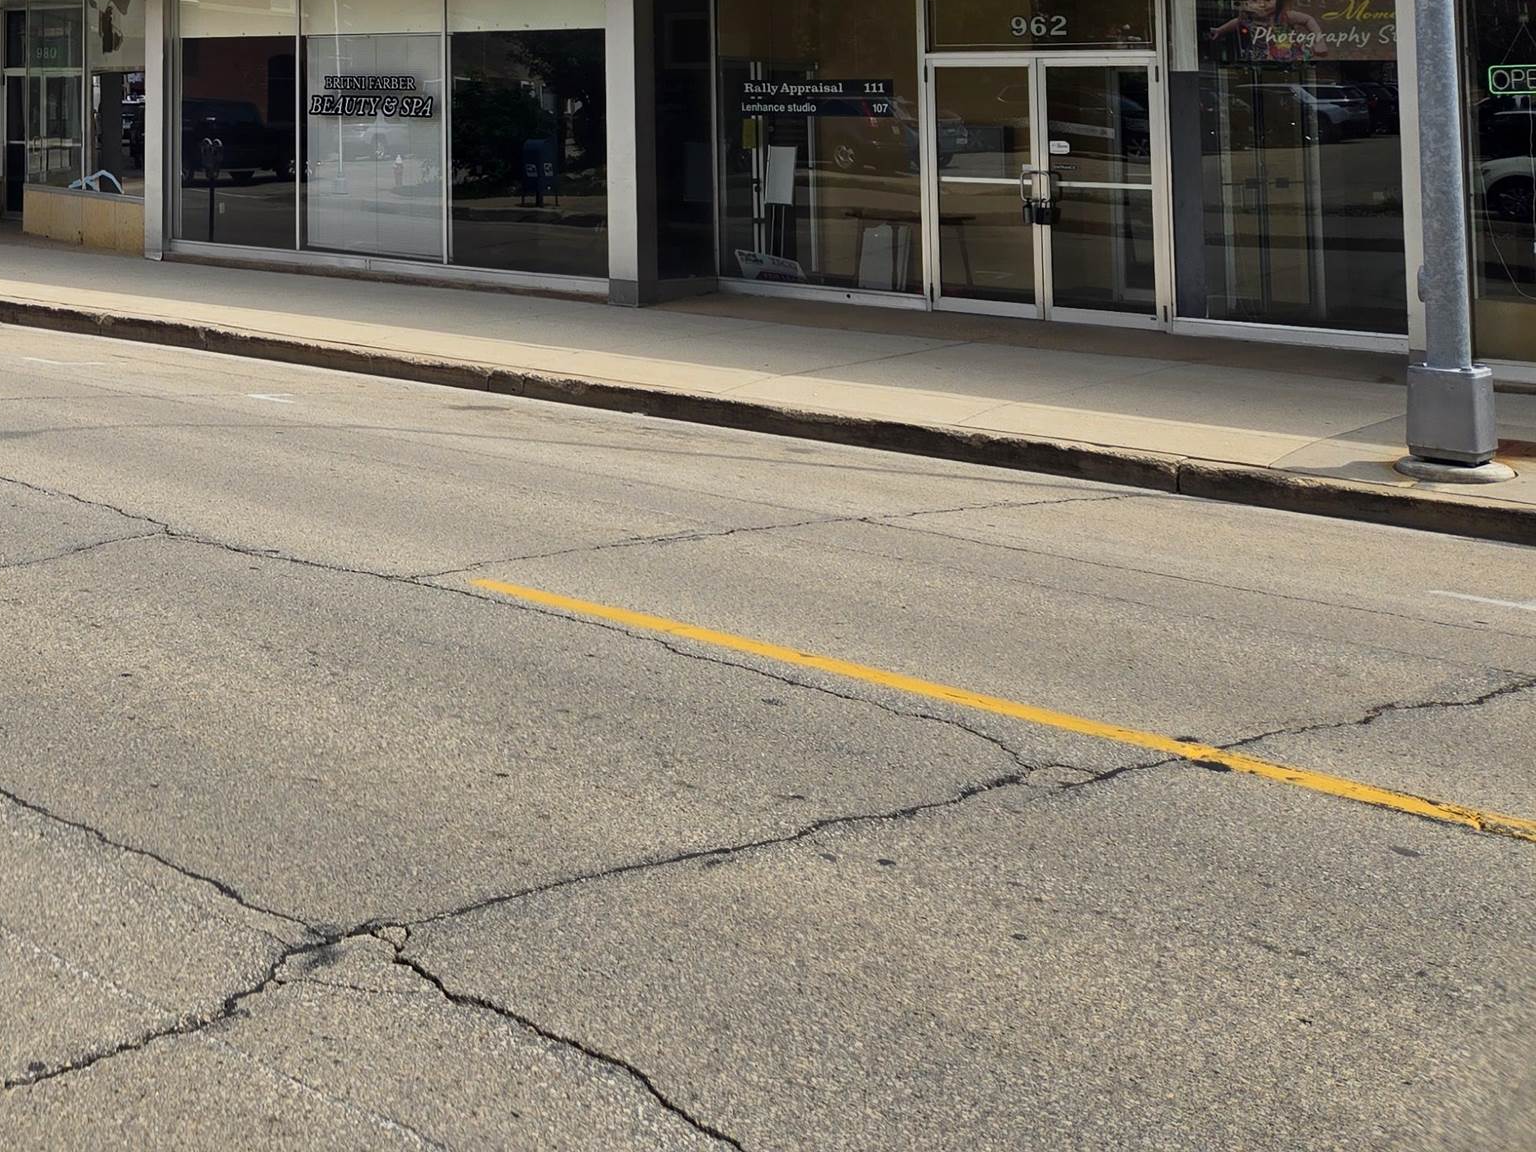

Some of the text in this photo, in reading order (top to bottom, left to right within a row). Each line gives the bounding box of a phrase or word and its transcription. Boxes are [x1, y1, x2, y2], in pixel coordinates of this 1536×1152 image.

[1010, 15, 1067, 37] 962
[1252, 26, 1371, 47] Photography
[36, 47, 57, 58] 980
[325, 76, 416, 90] BRITNI FARBER
[744, 82, 885, 96] Rally Appraisal 111
[310, 96, 433, 116] BEAUTY & SPA
[787, 102, 817, 112] studio
[872, 103, 889, 113] 107
